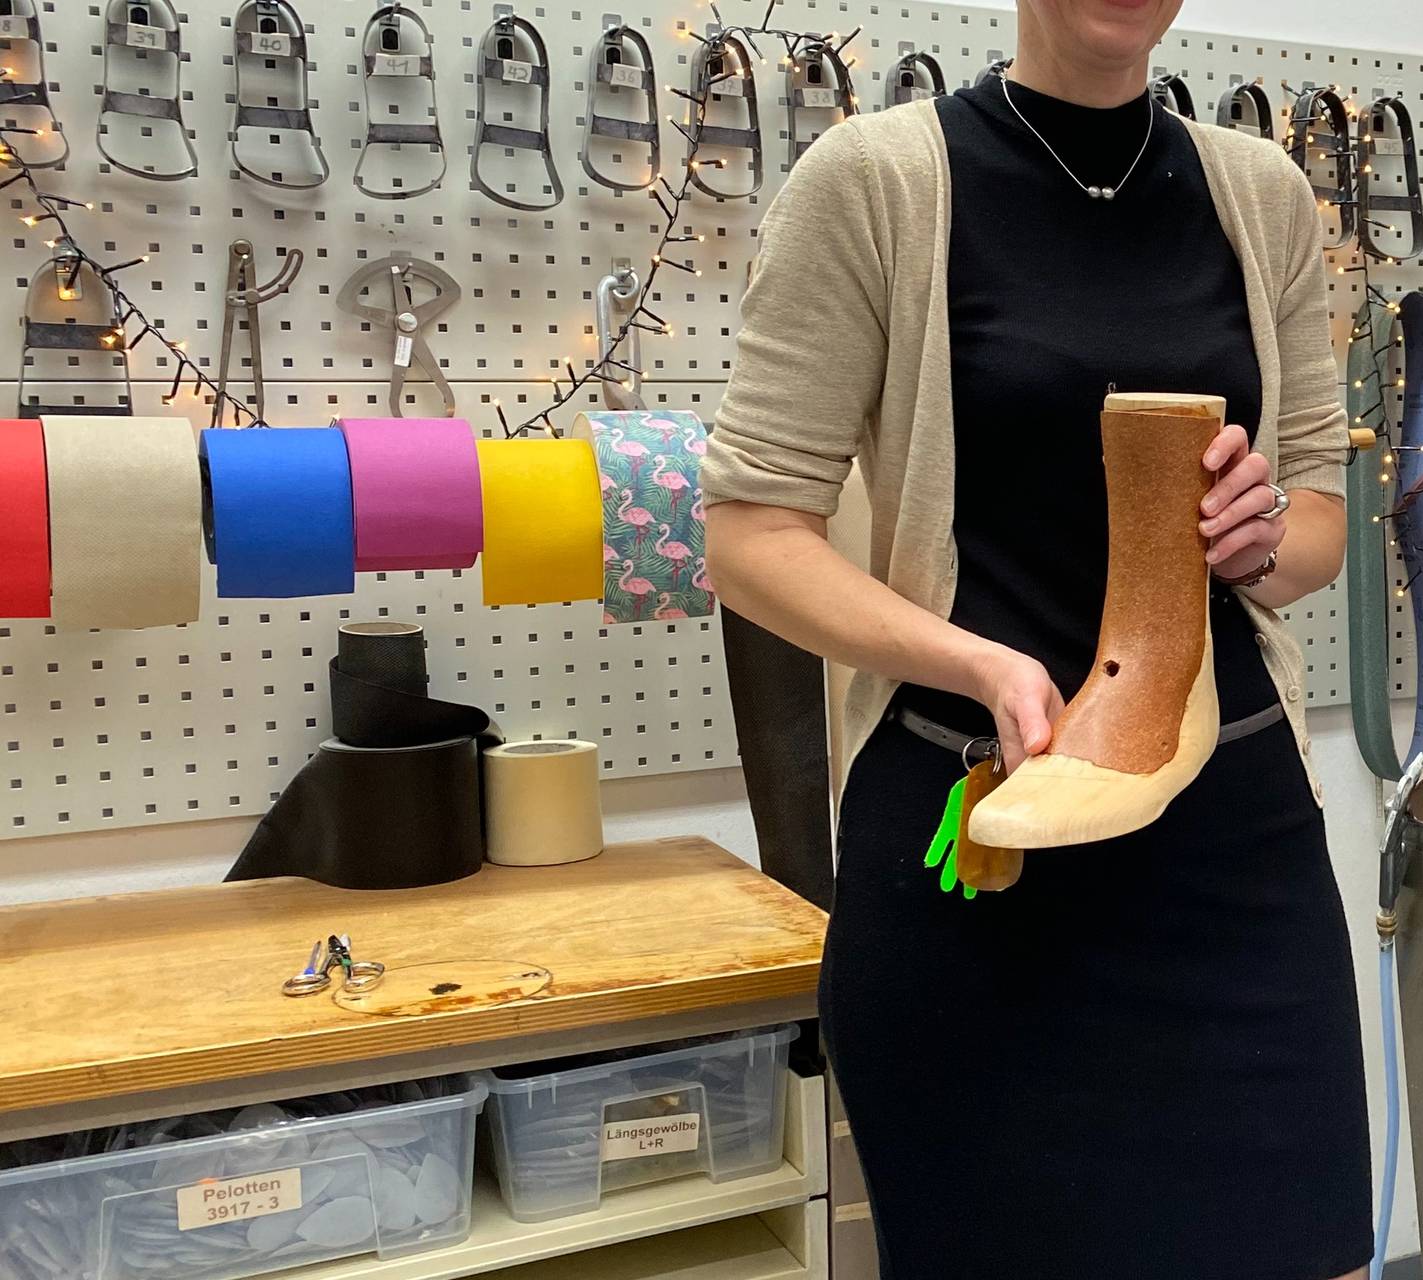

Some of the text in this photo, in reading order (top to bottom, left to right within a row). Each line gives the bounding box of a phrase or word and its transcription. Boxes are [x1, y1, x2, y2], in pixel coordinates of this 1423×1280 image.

[134, 31, 156, 46] 39
[260, 37, 282, 51] 40
[386, 59, 409, 75] 41
[508, 65, 529, 81] 42
[607, 1121, 697, 1140] Längsgewölbe
[639, 1138, 664, 1150] L+R
[203, 1179, 281, 1203] Pelotten
[207, 1201, 250, 1221] 3917
[270, 1196, 280, 1210] 3
